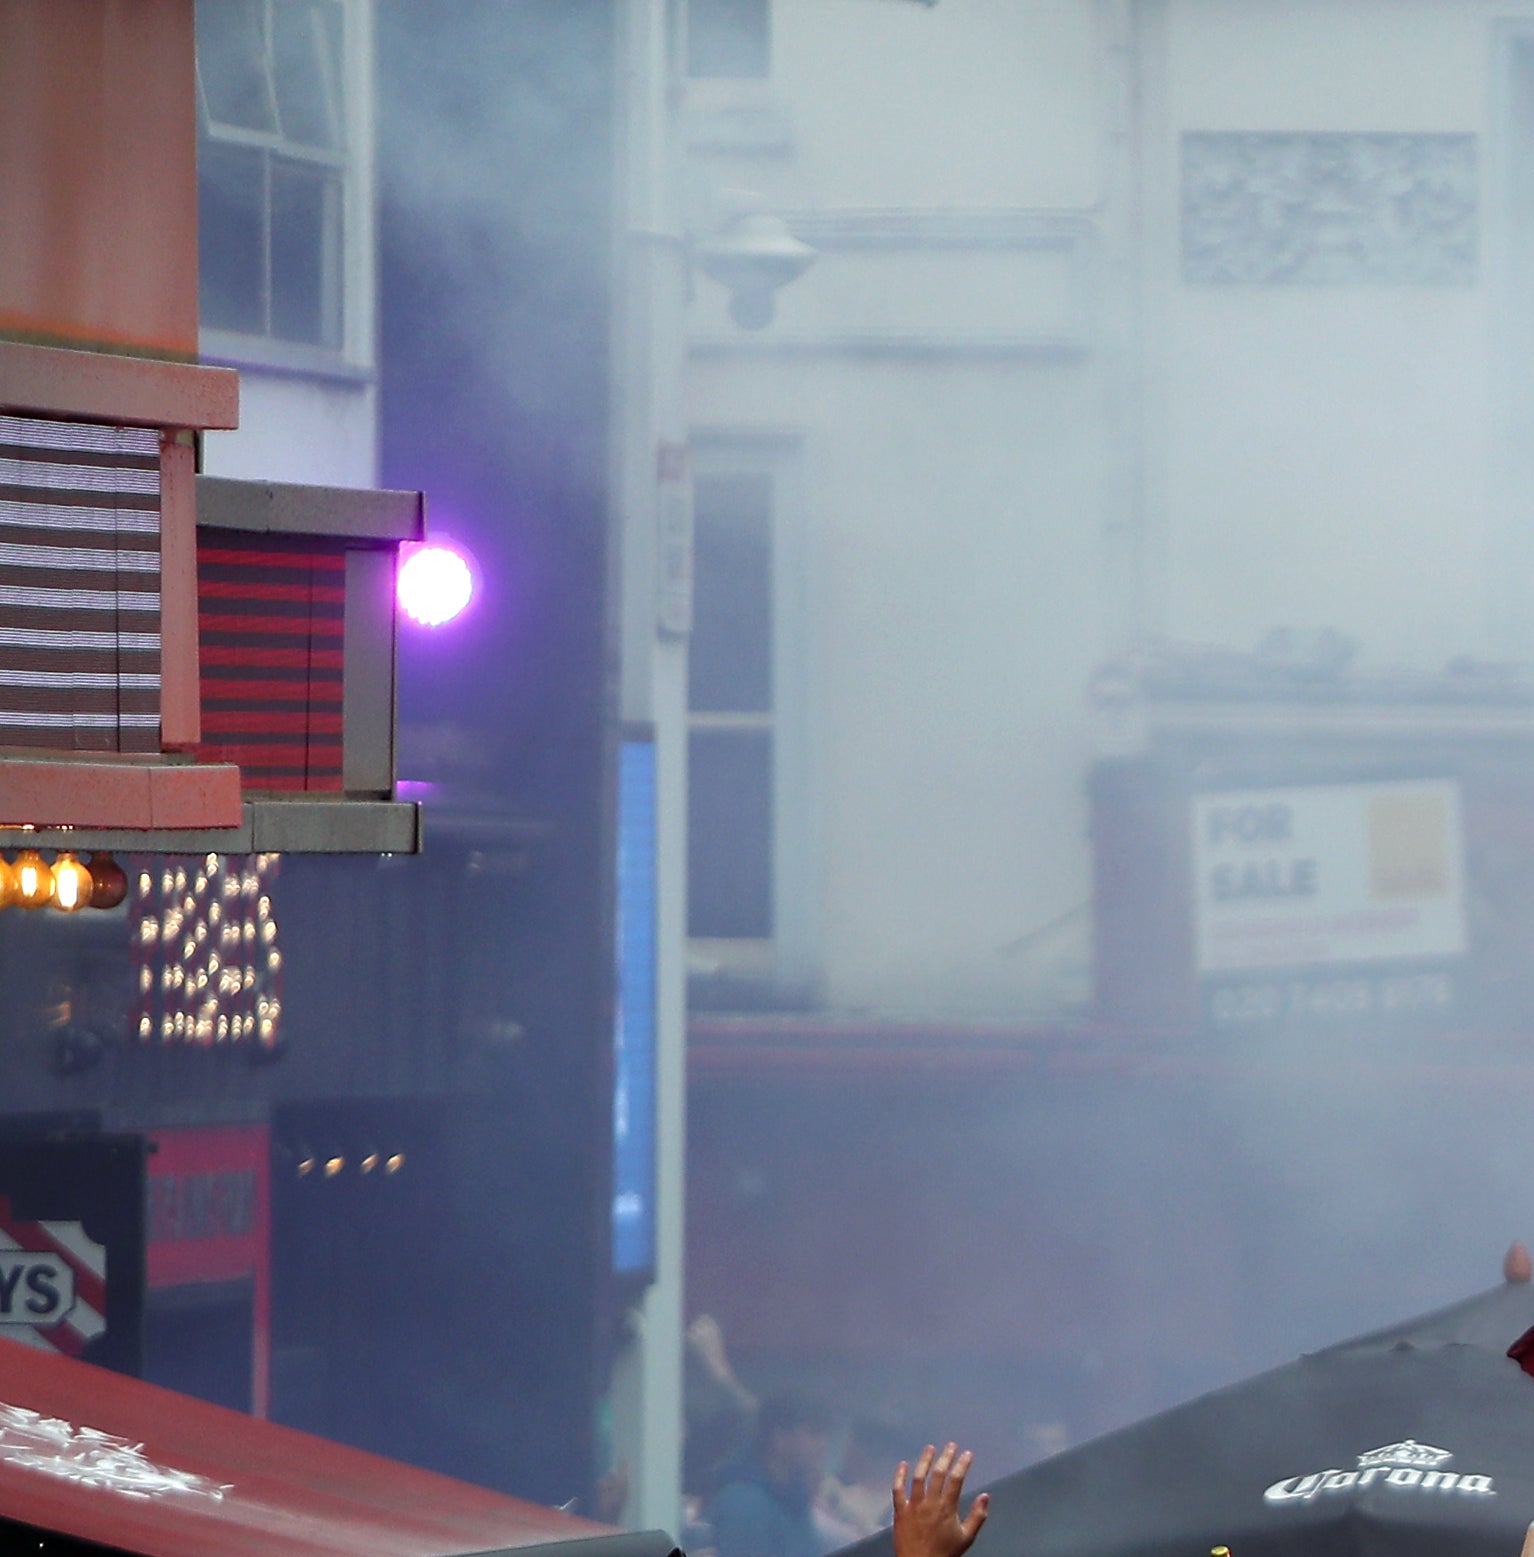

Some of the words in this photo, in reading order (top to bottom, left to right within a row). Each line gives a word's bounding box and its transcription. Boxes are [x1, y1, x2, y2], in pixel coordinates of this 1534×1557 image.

[1207, 803, 1295, 846] FOR
[1211, 857, 1319, 902] SALE
[1263, 1467, 1497, 1501] Corona
